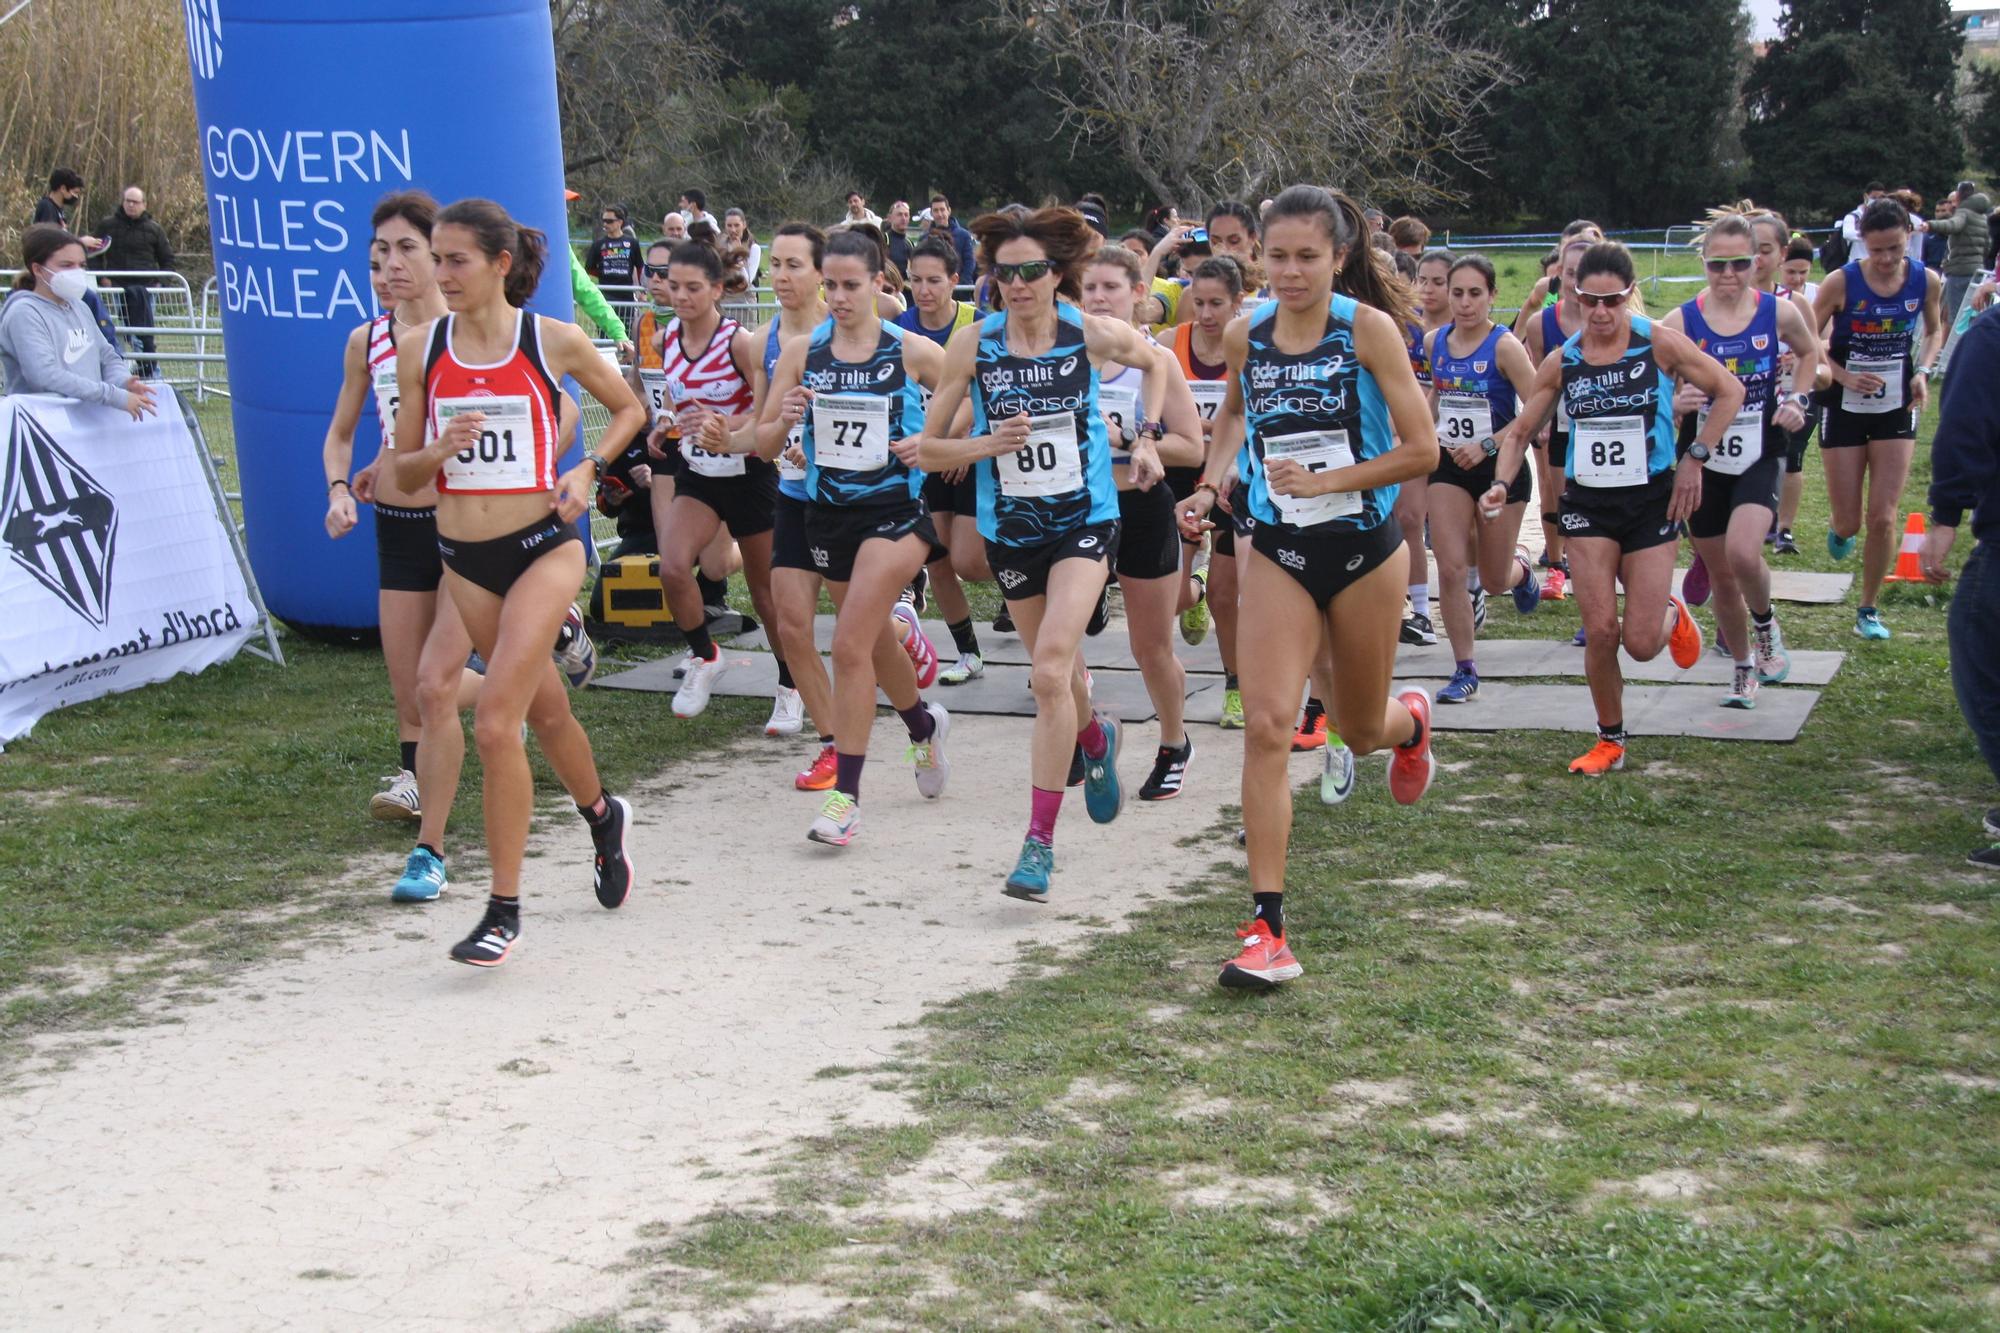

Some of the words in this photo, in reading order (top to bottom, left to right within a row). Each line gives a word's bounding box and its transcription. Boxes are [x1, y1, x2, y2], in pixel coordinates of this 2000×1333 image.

[206, 124, 412, 183] GOVERN
[214, 193, 349, 252] ILLES
[222, 261, 380, 319] BALEA
[841, 369, 872, 385] TRIBE
[982, 367, 1014, 385] ada
[1018, 365, 1055, 383] TRIBE
[1251, 361, 1280, 380] ada
[1284, 362, 1317, 381] TRIBE
[1567, 376, 1592, 394] ada
[1595, 371, 1626, 386] TRIBE
[987, 390, 1083, 415] vistasol
[1249, 389, 1347, 413] vistasol
[1568, 388, 1650, 415] vistasol
[833, 420, 867, 448] 77
[1447, 417, 1475, 439] 39
[1016, 442, 1057, 473] 80
[1591, 441, 1626, 467] 82
[1277, 548, 1306, 565] ada
